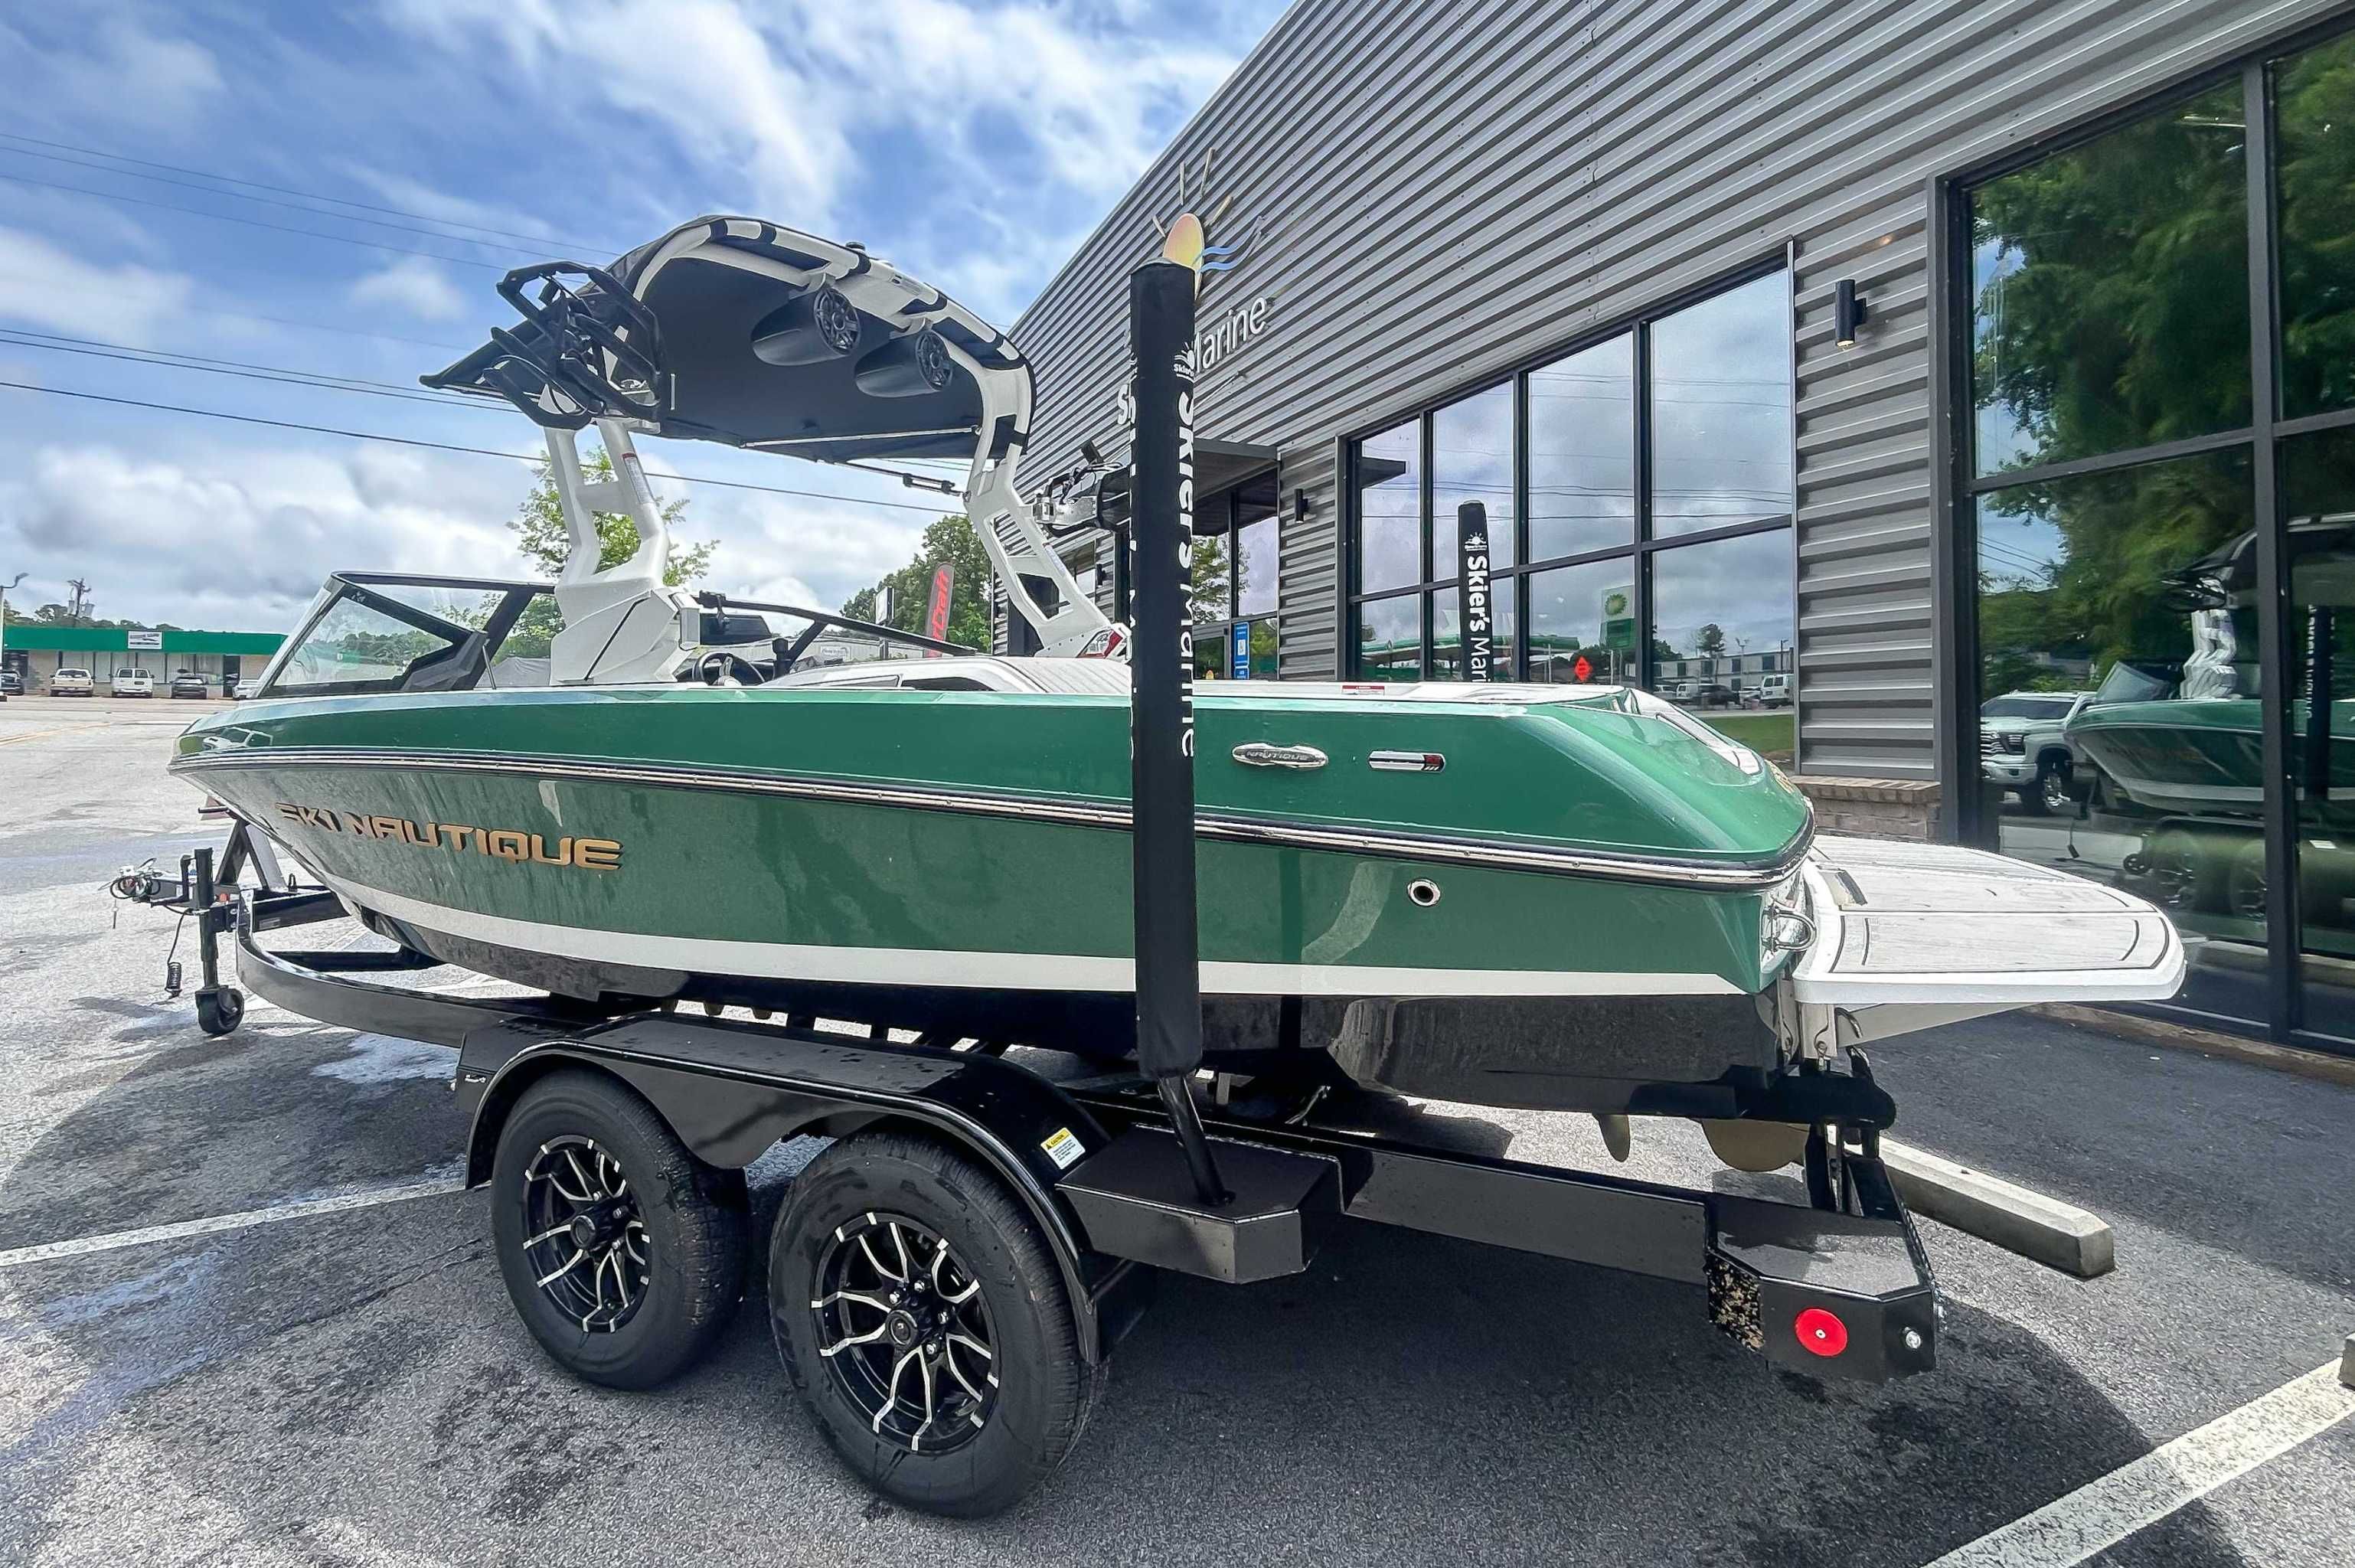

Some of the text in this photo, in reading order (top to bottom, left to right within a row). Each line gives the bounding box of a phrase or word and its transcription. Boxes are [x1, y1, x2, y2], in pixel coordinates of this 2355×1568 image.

[1467, 555, 1491, 632] Skier's
[1470, 637, 1491, 683] Mari
[342, 811, 623, 871] NAUTIQUE
